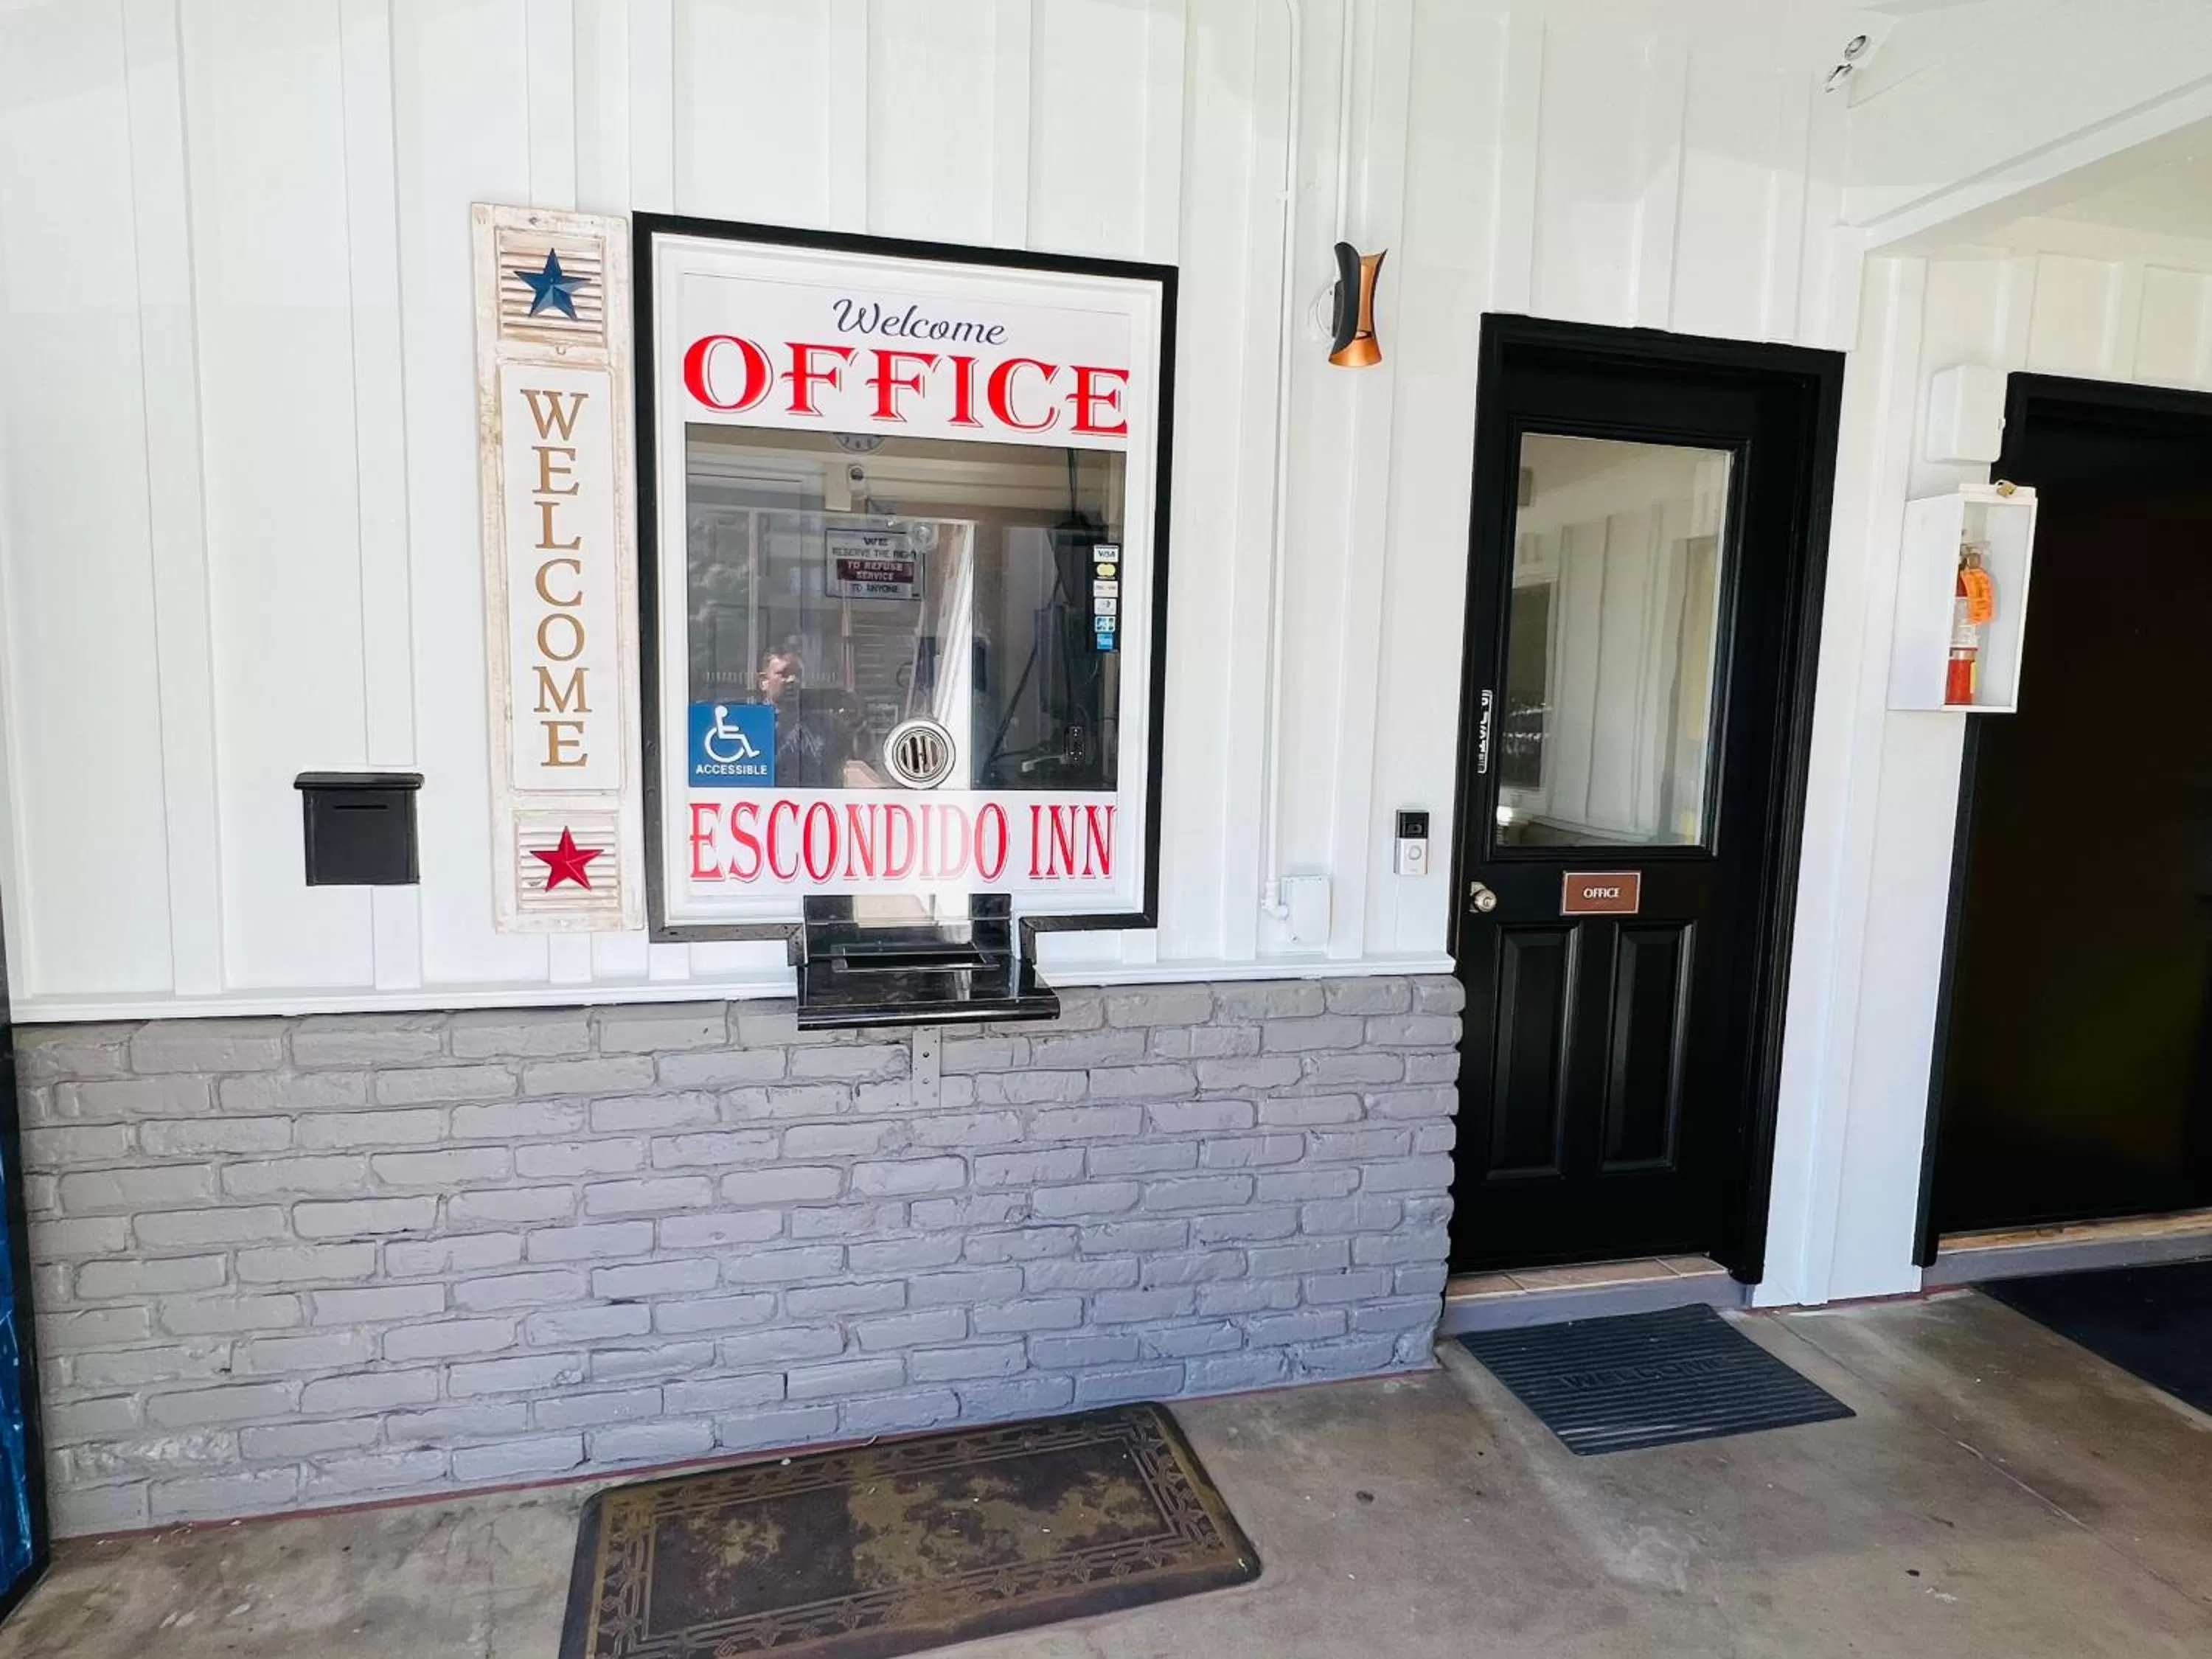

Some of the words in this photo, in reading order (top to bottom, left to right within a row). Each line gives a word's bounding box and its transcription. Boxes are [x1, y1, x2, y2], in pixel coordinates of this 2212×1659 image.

[832, 298, 1008, 345] Welcome
[683, 333, 1130, 437] OFFICE
[863, 536, 888, 546] WE
[848, 560, 860, 569] TO
[864, 561, 903, 571] REFUSE
[520, 389, 593, 768] WELCOME
[856, 571, 894, 581] SERVICE
[695, 764, 768, 775] ACCESSIBLE
[688, 799, 1009, 884] ESCONDIDO
[1028, 804, 1118, 880] INN
[1583, 886, 1621, 899] OFFICE
